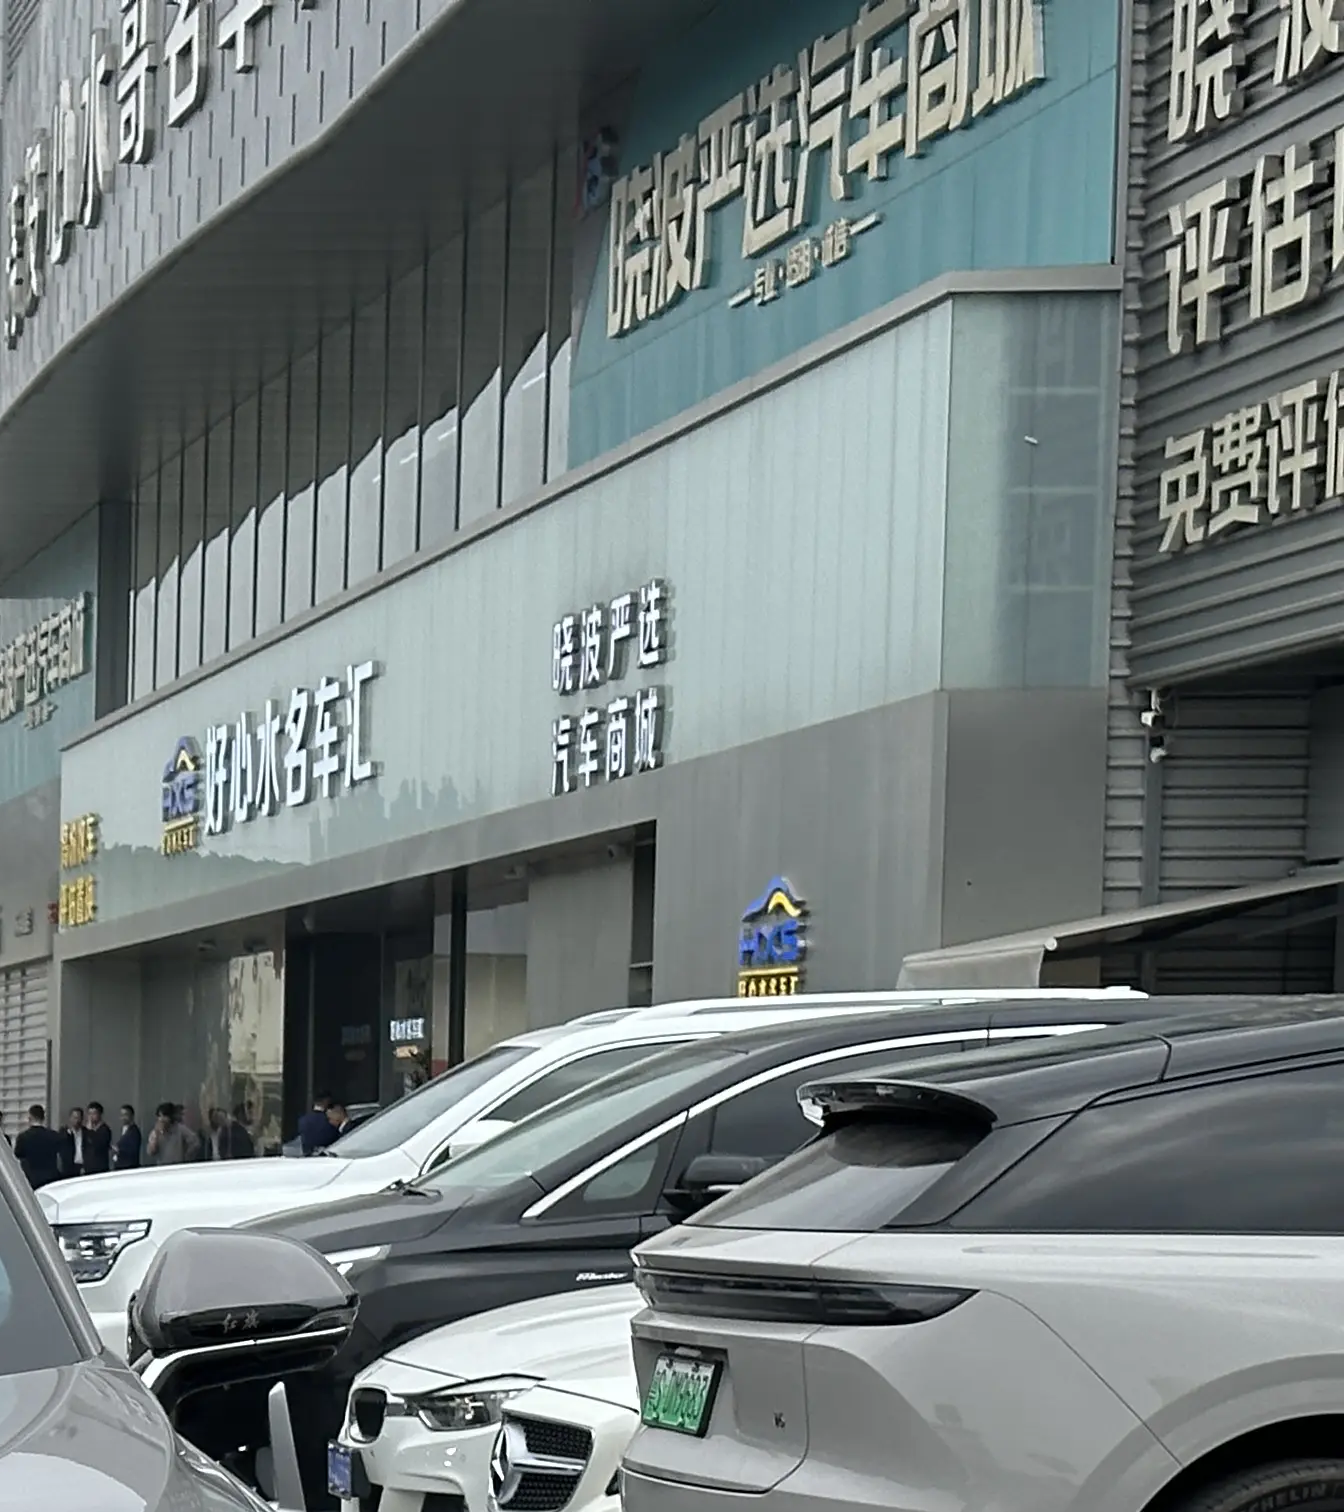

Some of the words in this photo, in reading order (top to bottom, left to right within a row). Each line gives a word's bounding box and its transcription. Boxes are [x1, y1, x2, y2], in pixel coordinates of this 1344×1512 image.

[1166, 128, 1344, 356] 评估
[551, 577, 663, 693] 晓波严选
[204, 660, 376, 836] 好心水名车汇
[551, 686, 662, 796] 汽车商城
